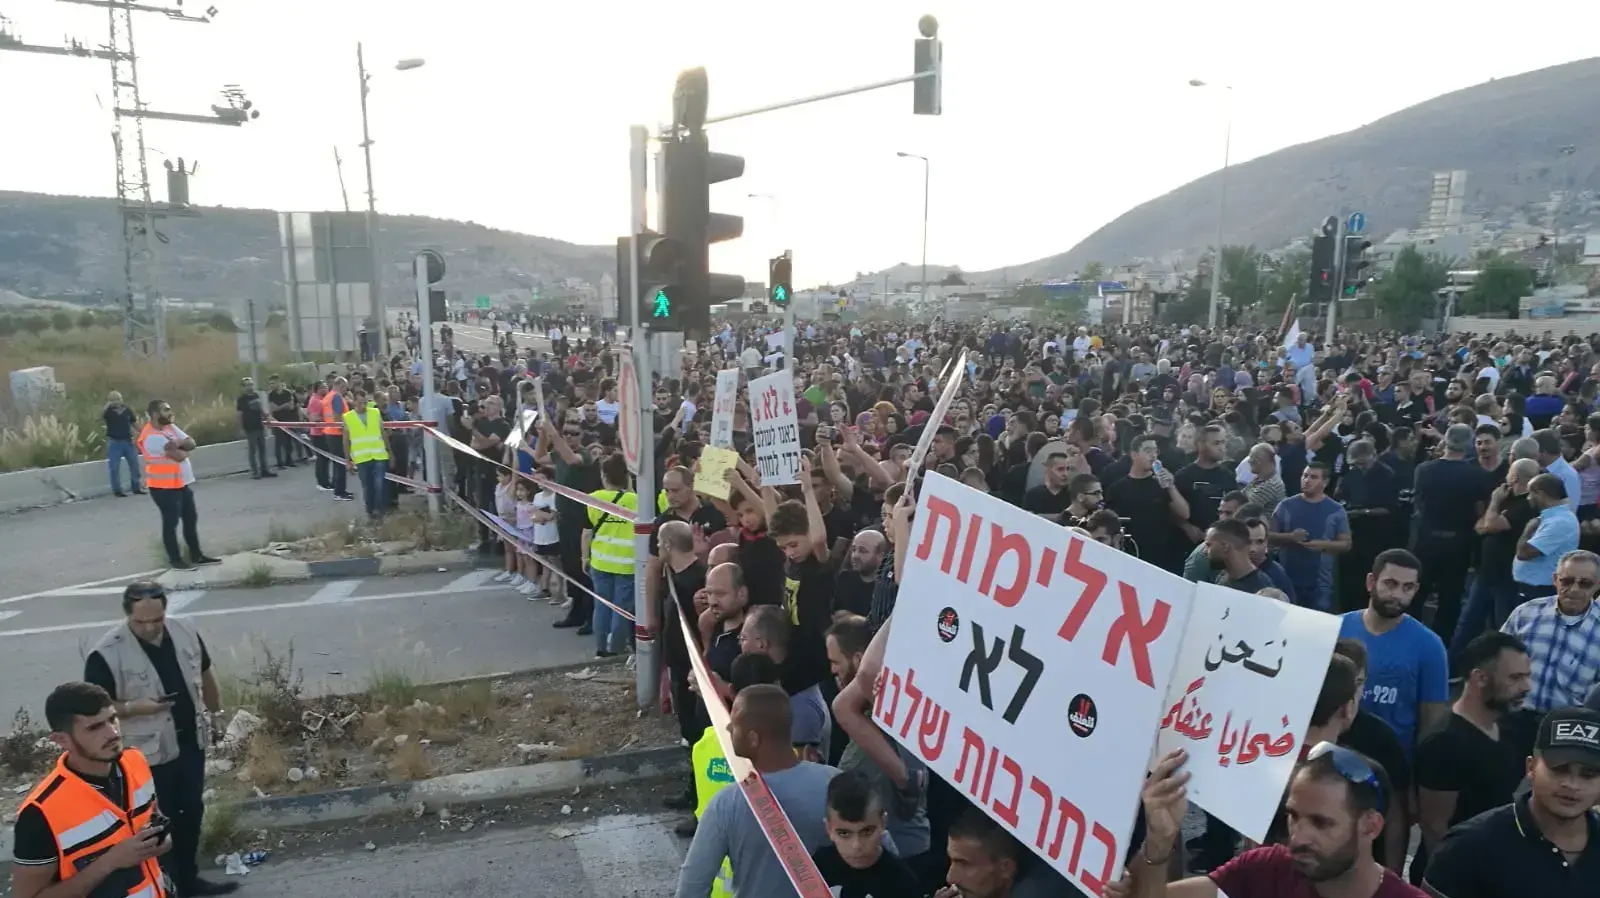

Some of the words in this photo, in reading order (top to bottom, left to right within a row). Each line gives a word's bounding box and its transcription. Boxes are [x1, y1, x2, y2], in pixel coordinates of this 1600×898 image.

[763, 384, 778, 420] לא
[915, 494, 1172, 688] אלימות
[874, 666, 951, 762] שלנו
[958, 620, 1044, 725] לא
[1218, 709, 1295, 768] ضحايا
[1556, 723, 1600, 739] EA7
[954, 726, 1117, 897] בתרבות
